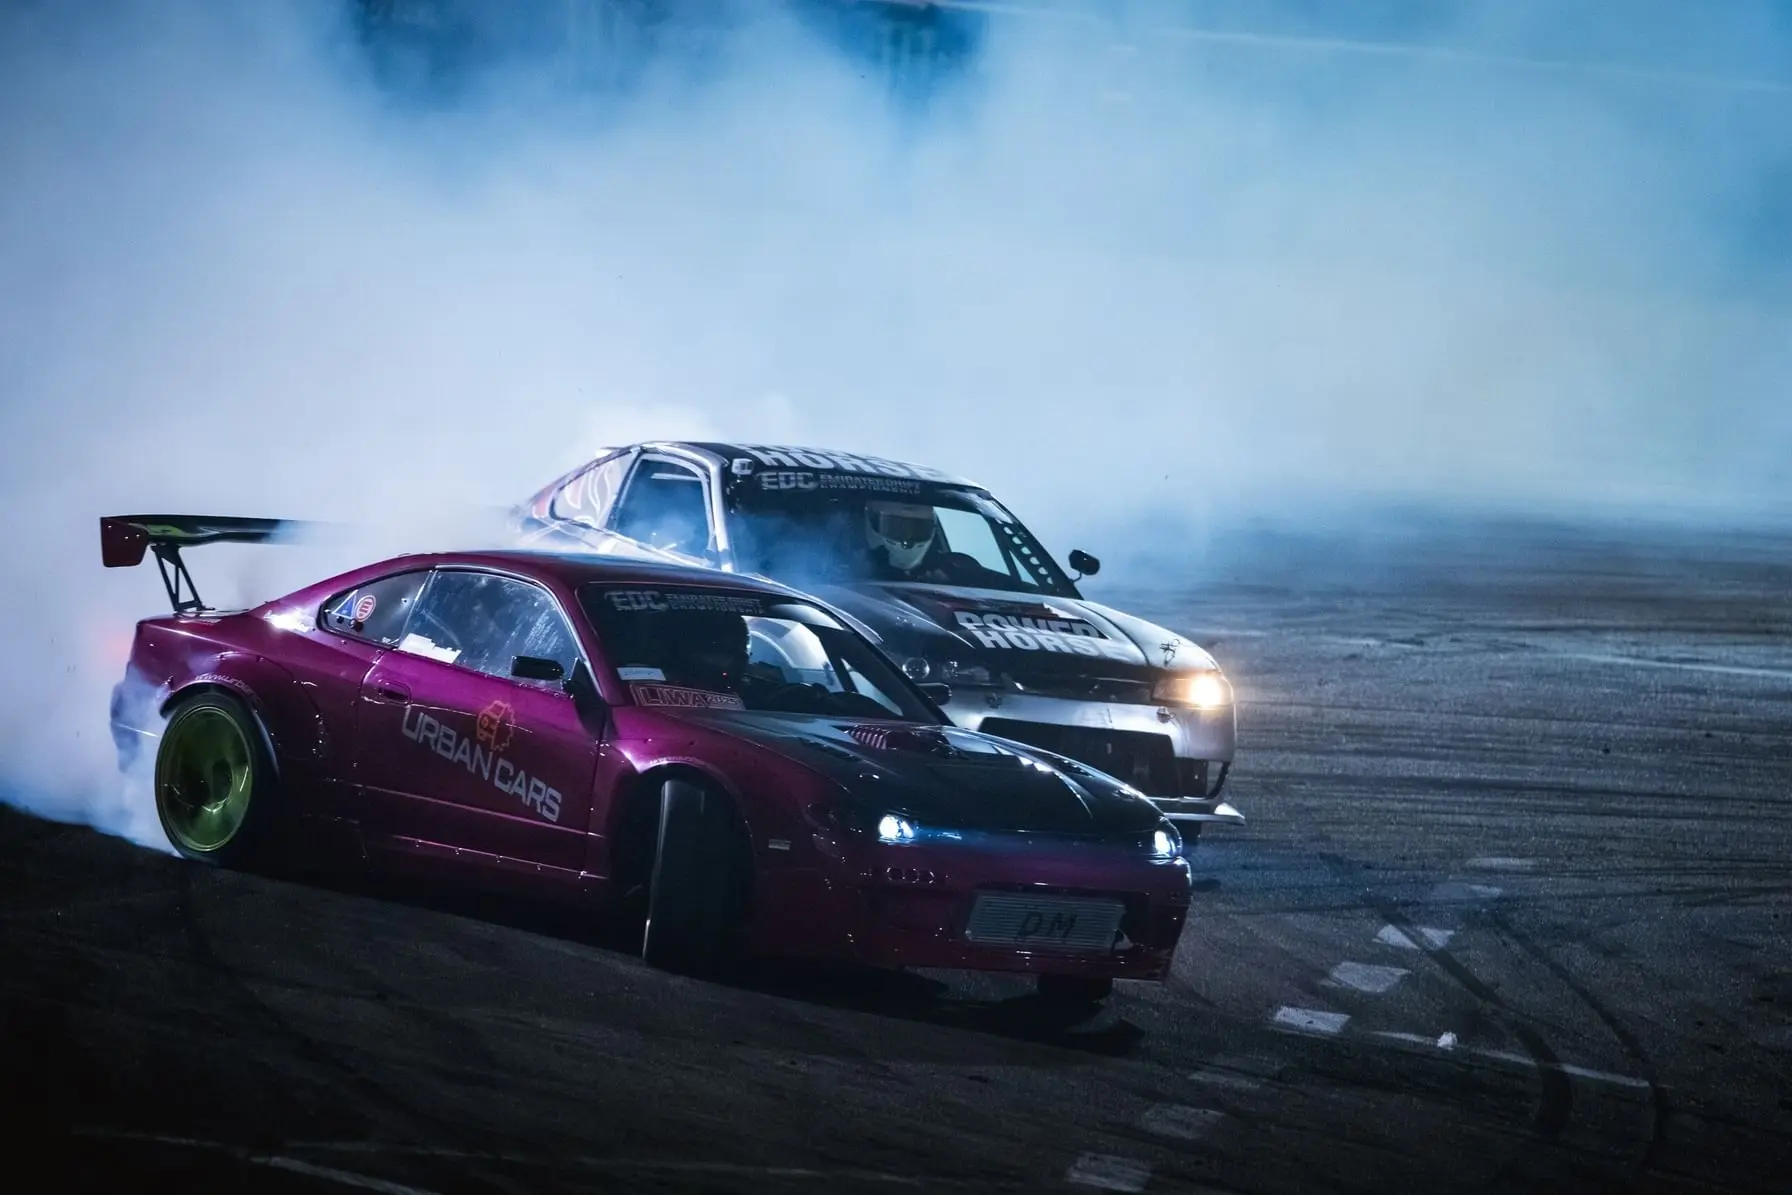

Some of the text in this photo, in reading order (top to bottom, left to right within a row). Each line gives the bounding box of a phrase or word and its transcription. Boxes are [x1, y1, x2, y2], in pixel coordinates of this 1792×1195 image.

[745, 448, 950, 480] HORSE
[758, 471, 817, 490] EDC
[606, 590, 667, 612] EDC
[972, 630, 1137, 664] HORSE
[639, 686, 709, 707] LIWA
[401, 705, 562, 822] URBAN CARS
